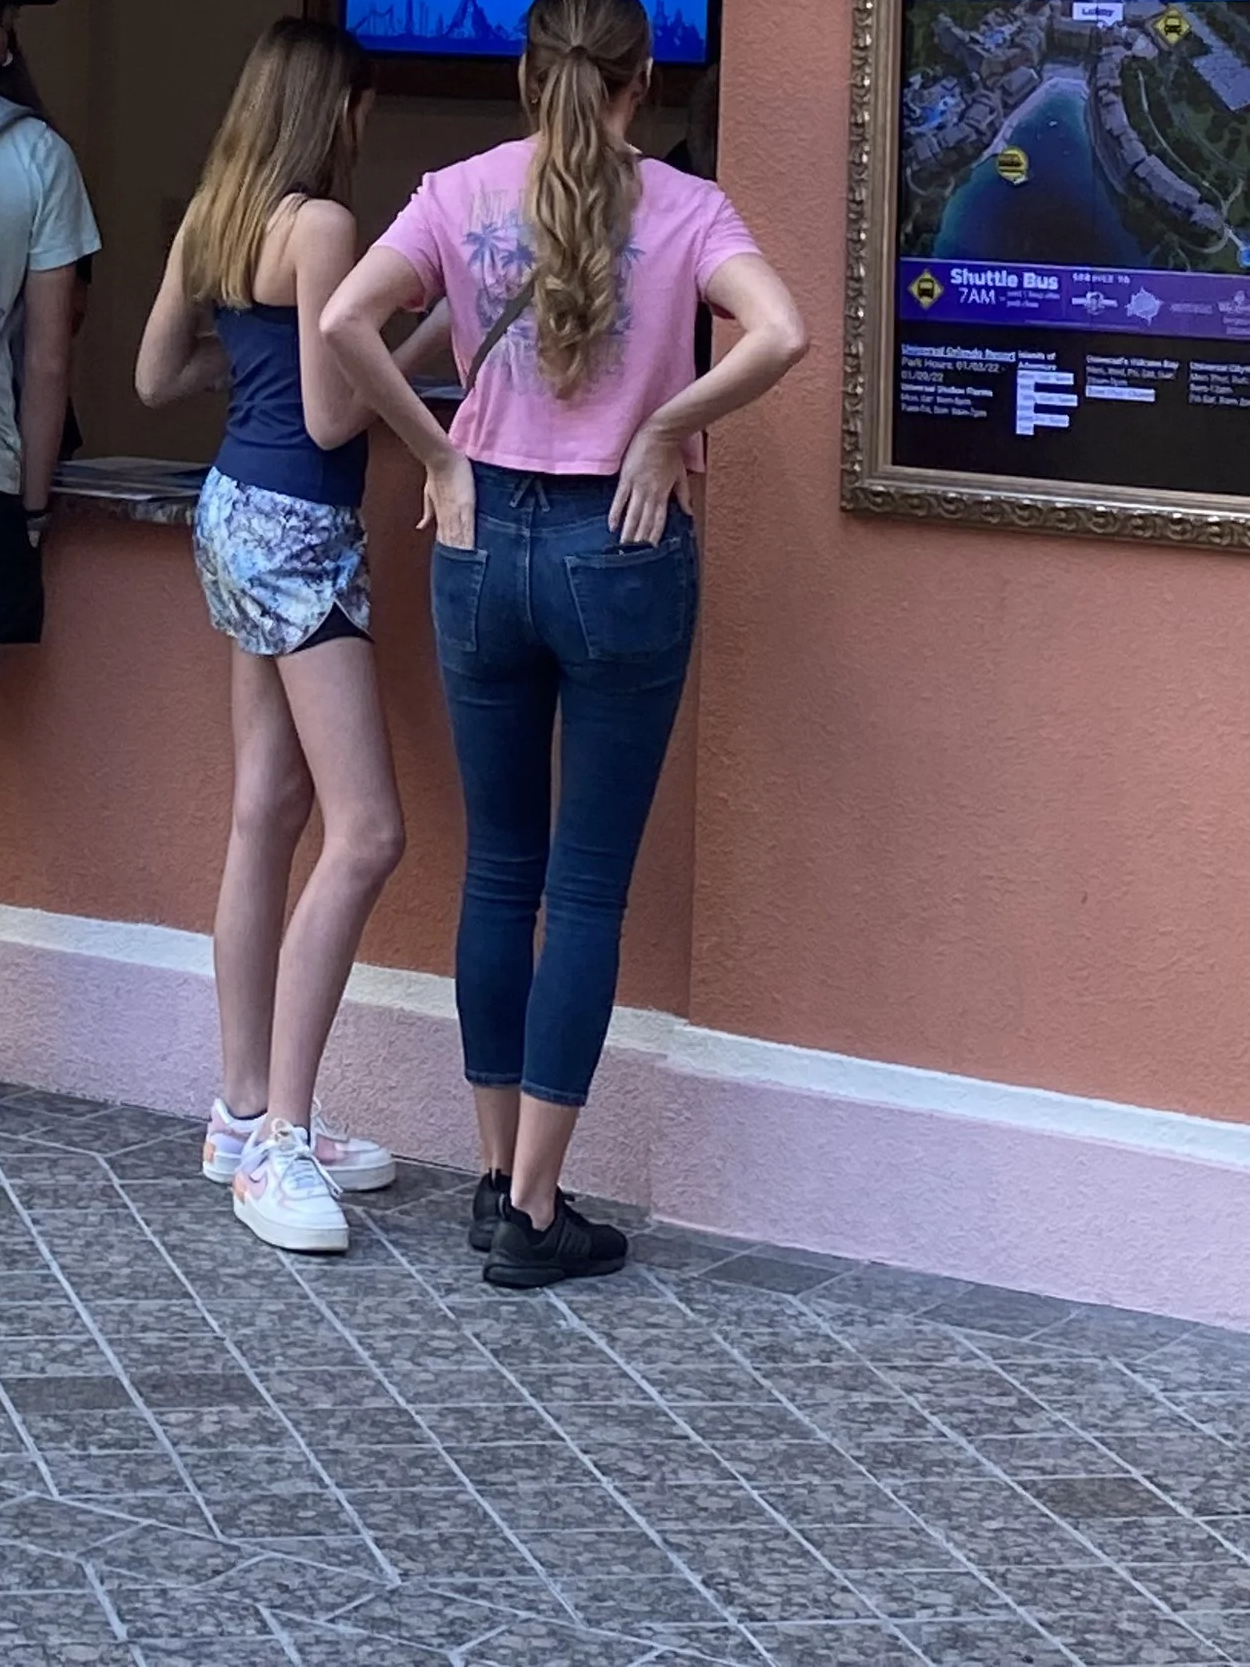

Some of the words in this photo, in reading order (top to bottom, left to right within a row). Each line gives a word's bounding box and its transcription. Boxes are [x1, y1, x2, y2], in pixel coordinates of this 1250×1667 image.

[950, 268, 1019, 288] Shuttle
[1022, 271, 1059, 290] Bus
[958, 287, 997, 305] 7AM
